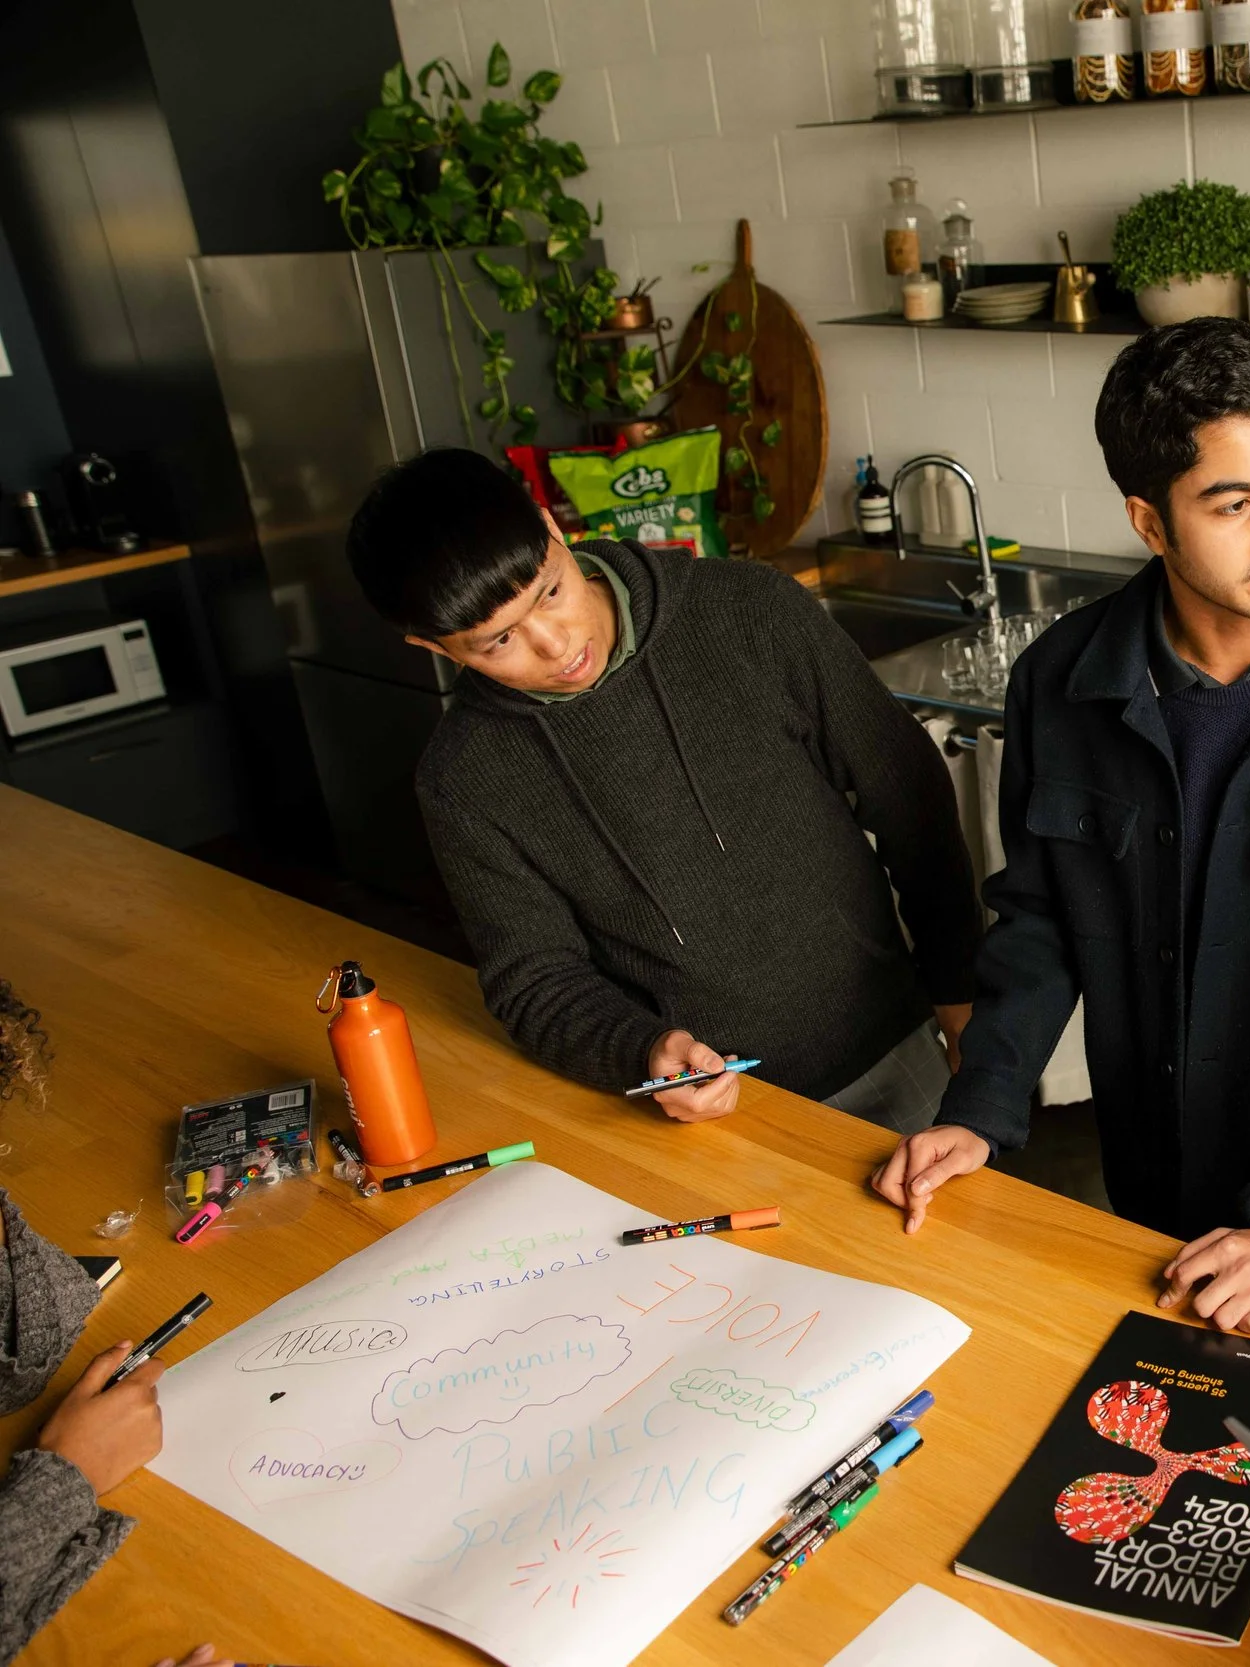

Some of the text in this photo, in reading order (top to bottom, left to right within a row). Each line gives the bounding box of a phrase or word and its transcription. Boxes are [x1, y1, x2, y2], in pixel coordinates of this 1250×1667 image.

[616, 503, 676, 527] VARIETY
[671, 1224, 701, 1237] POSCA
[616, 1262, 821, 1358] VOICE
[391, 1340, 596, 1408] Community
[1136, 1360, 1224, 1388] shaping culture
[1160, 1377, 1228, 1398] 35 years of
[1094, 1536, 1247, 1583] REPORT
[1094, 1557, 1236, 1608] ANNUAL
